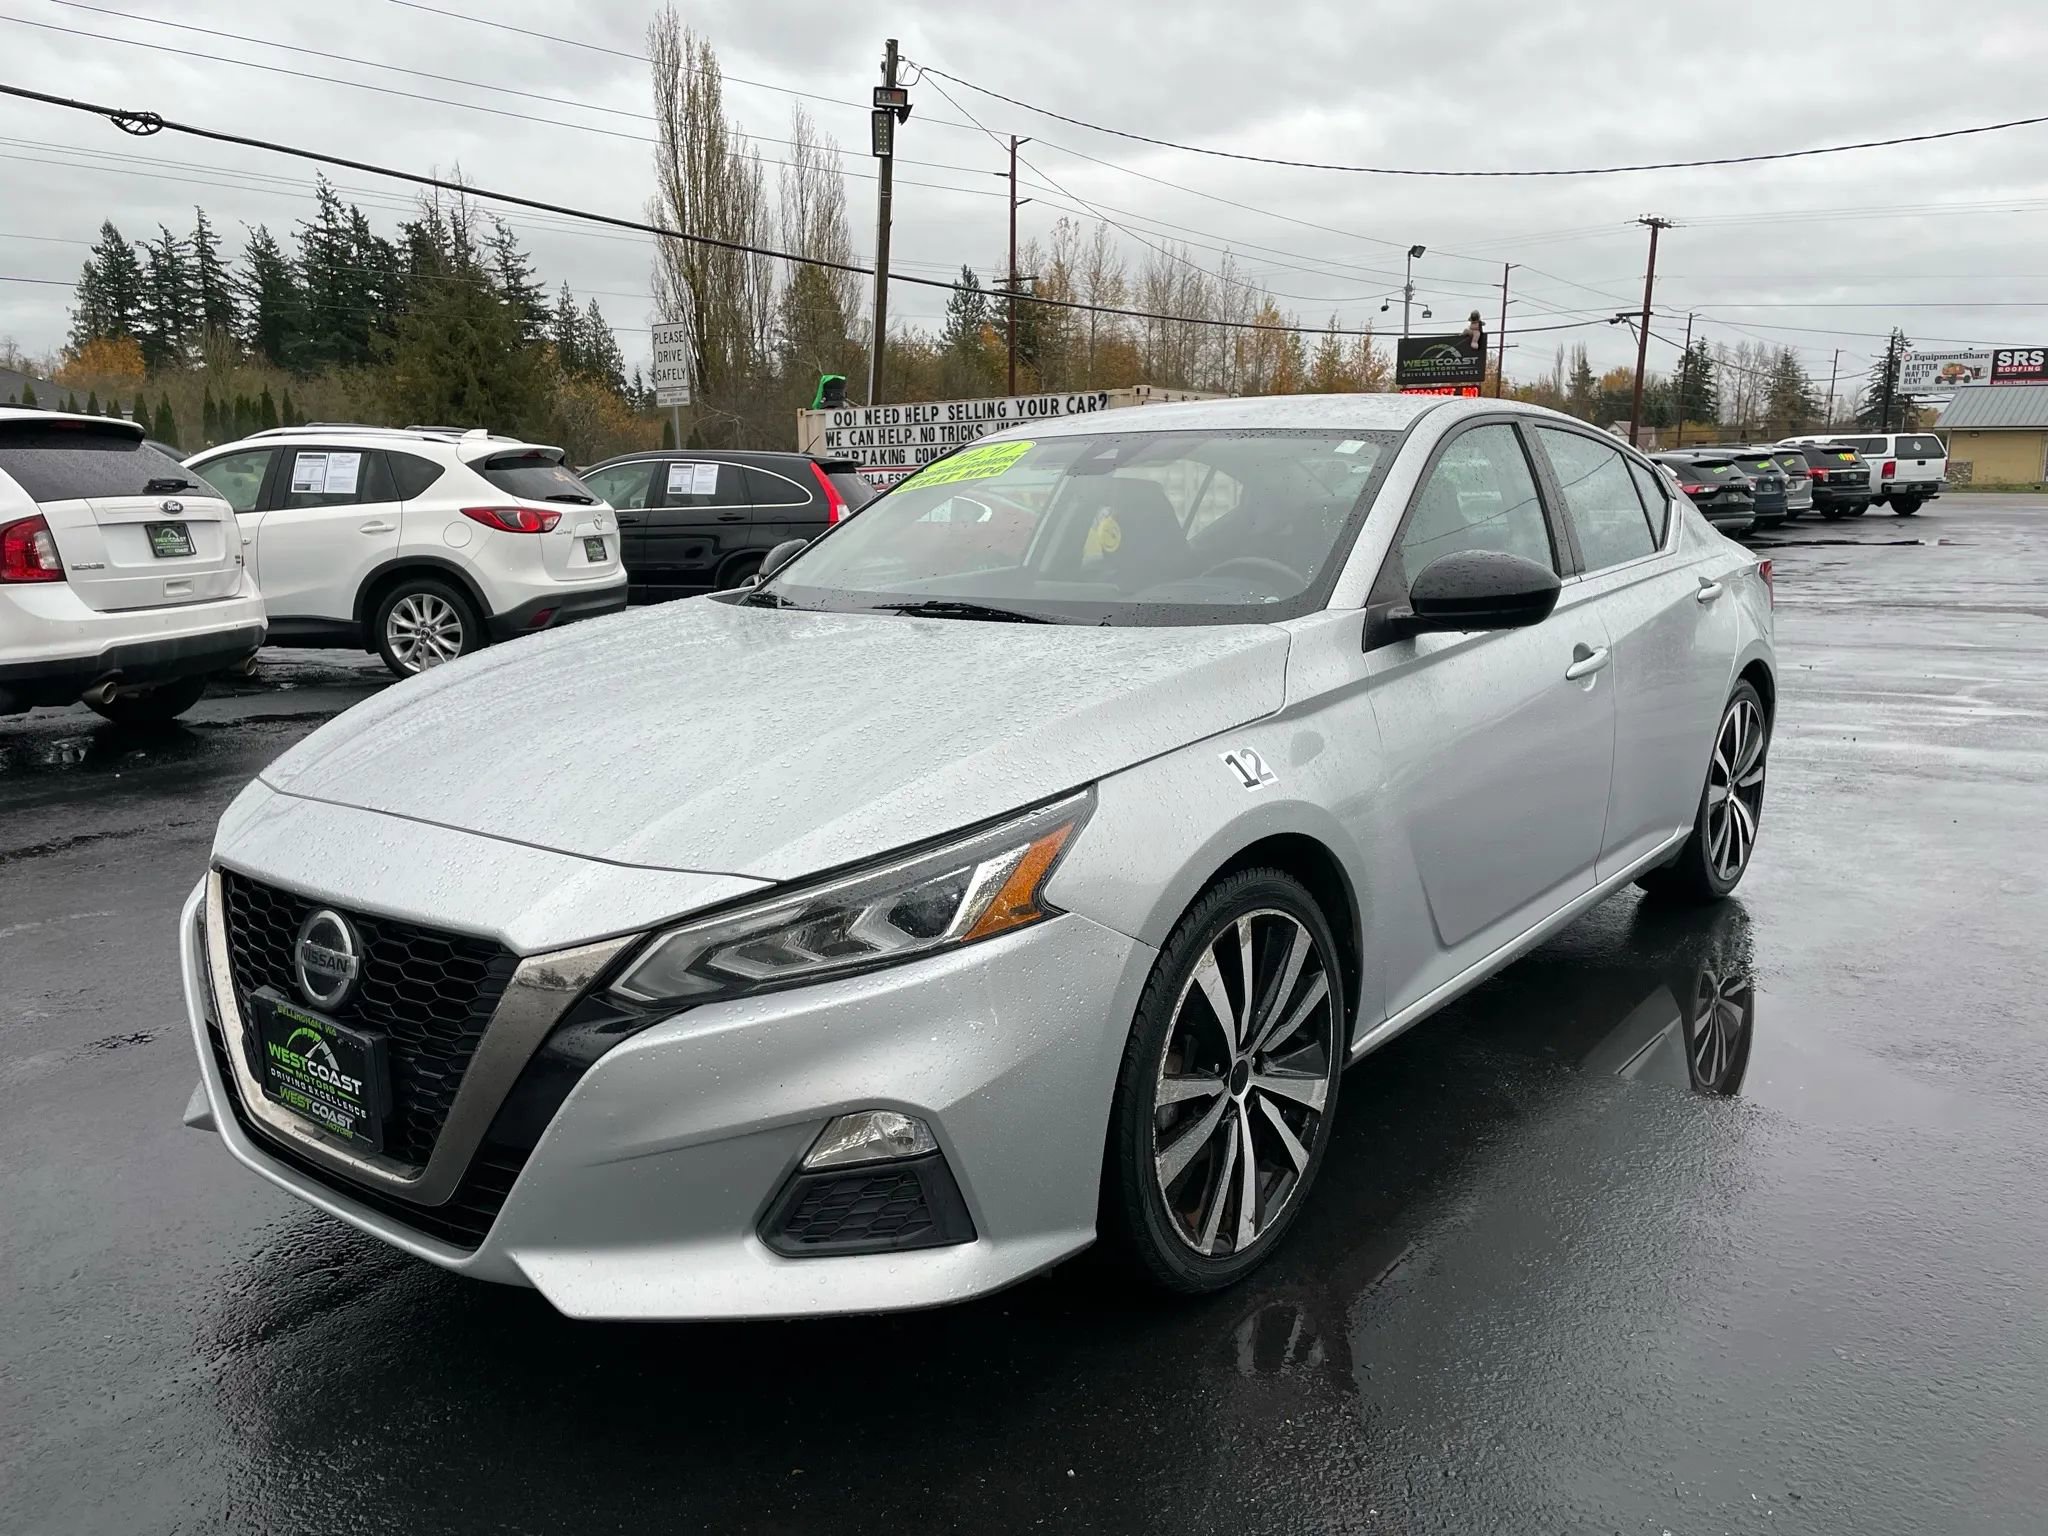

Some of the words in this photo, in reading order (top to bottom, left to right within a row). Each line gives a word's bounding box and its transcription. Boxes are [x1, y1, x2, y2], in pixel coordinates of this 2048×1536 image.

[654, 330, 684, 344] PLEASE
[658, 349, 683, 363] DRIVE
[1403, 357, 1479, 367] WESTCOAST
[1914, 353, 1990, 361] EquipmentShare
[1997, 350, 2045, 366] SRS
[657, 368, 686, 381] SAFELY
[865, 408, 900, 425] NEED
[905, 405, 939, 423] HELP
[948, 401, 1007, 421] SELLING
[1016, 397, 1060, 417] YOUR
[1066, 392, 1108, 415] CAR?
[826, 431, 842, 447] WE
[850, 429, 874, 446] CAN
[920, 426, 936, 443] NO
[1224, 748, 1275, 789] 12
[301, 946, 348, 973] NISSAN
[268, 1041, 362, 1095] WESTCOAST
[270, 1067, 306, 1090] DRIVING
[308, 1085, 367, 1119] EXCELLENCE
[295, 1070, 336, 1094] MOTORS
[280, 1086, 354, 1130] WESTCOAST
